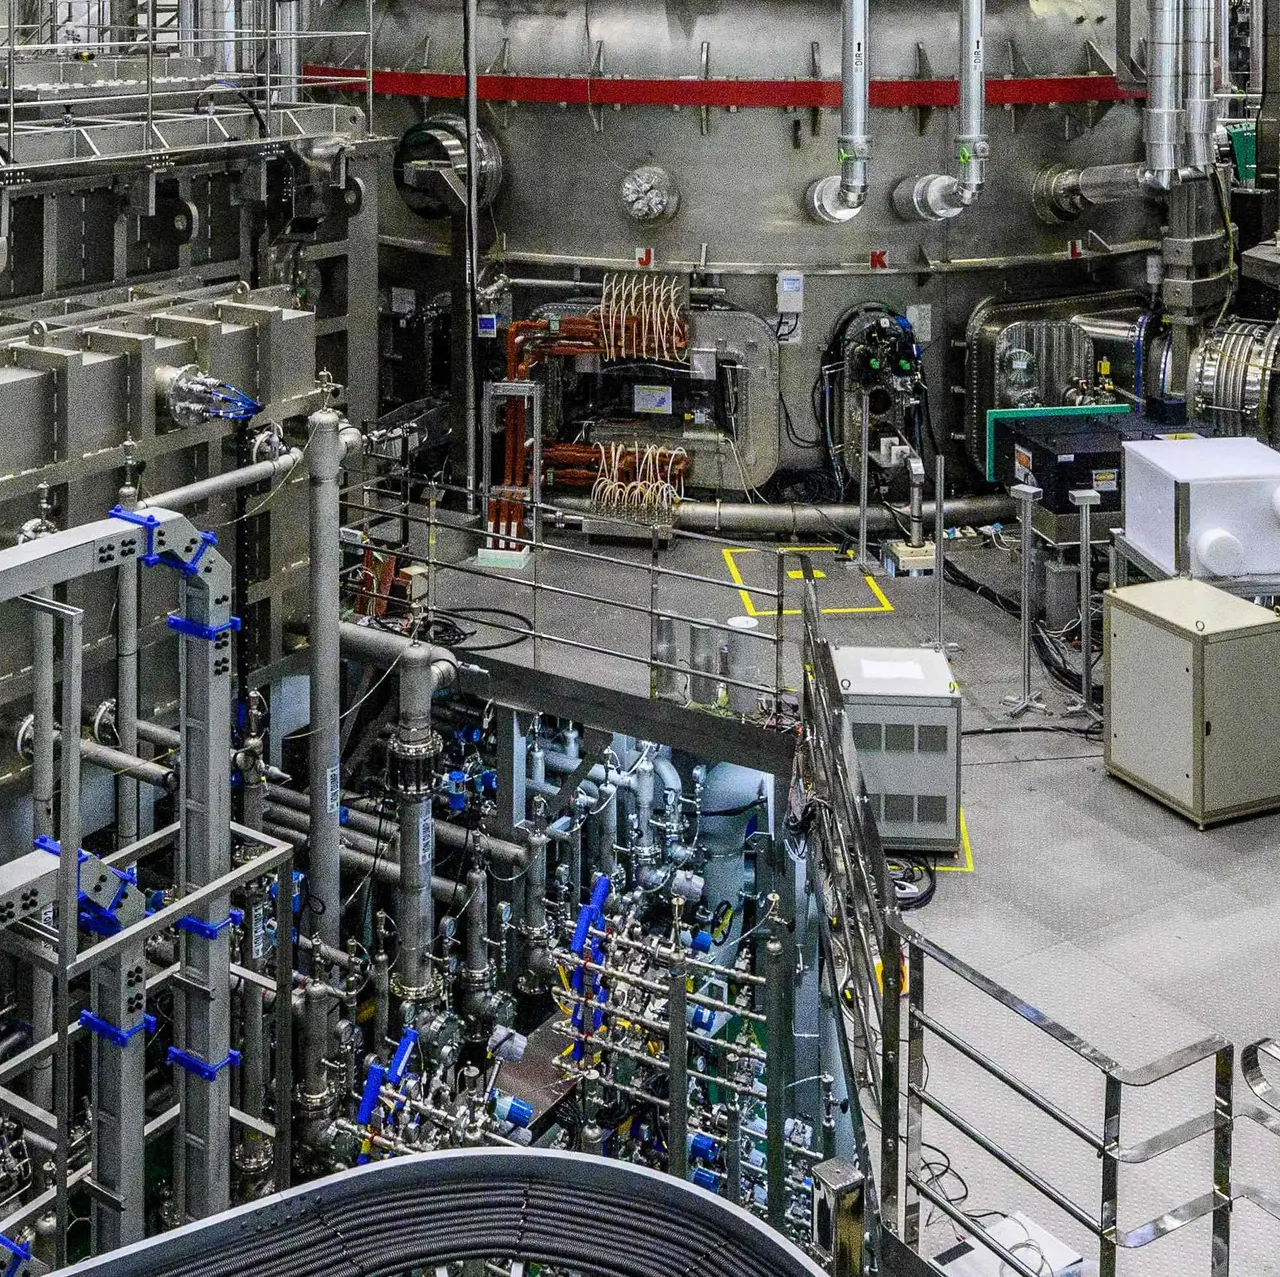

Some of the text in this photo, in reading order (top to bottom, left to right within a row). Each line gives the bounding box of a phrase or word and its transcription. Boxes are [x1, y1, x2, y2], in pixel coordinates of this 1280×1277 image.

[855, 52, 863, 66] DIR
[974, 50, 982, 64] DIR
[638, 246, 652, 267] J
[870, 250, 889, 269] K
